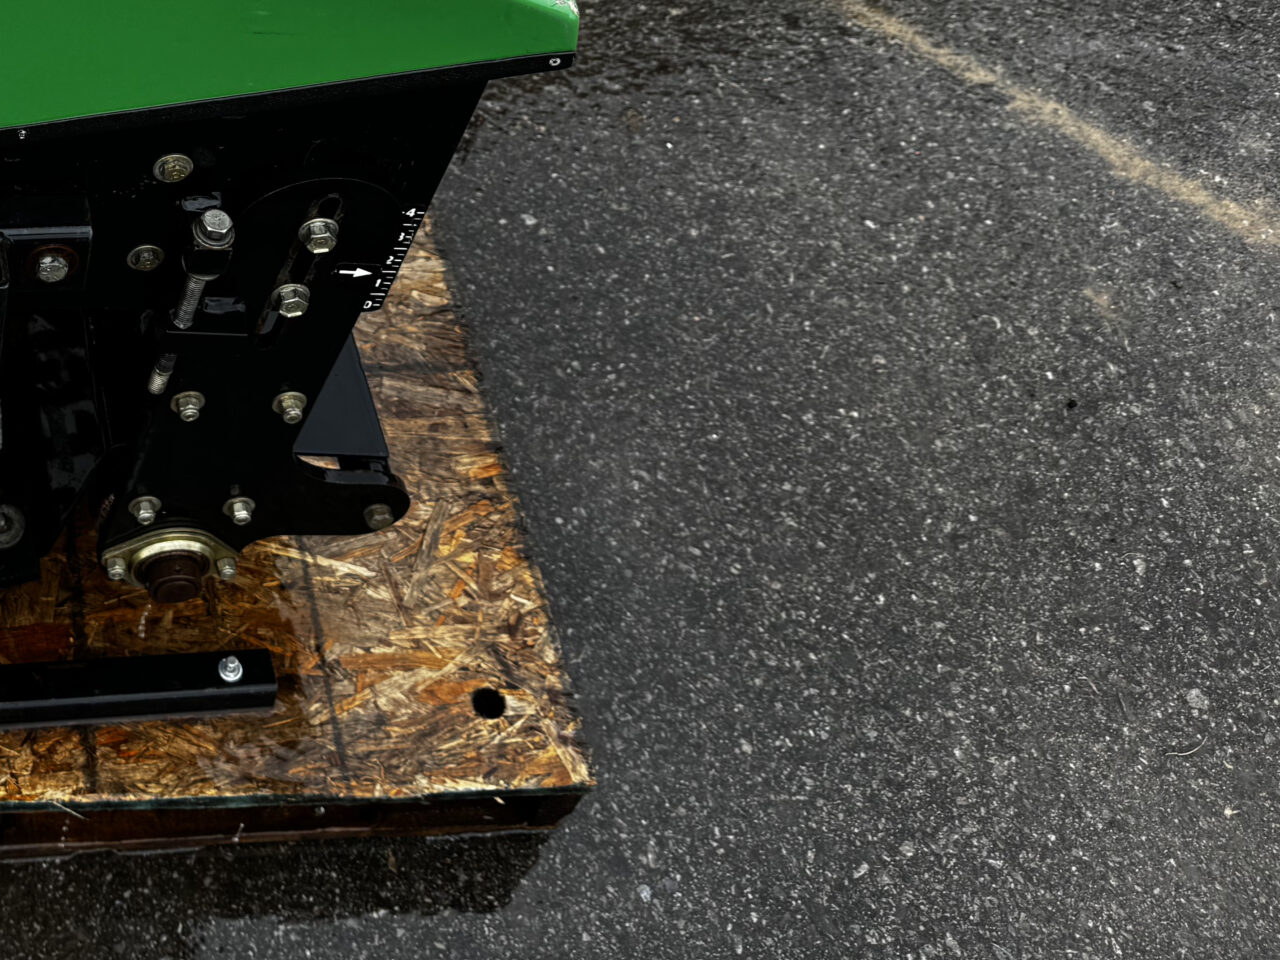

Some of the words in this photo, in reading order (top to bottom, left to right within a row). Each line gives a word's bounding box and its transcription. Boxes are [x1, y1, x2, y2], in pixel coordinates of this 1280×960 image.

[405, 208, 416, 217] 4
[386, 255, 394, 264] 2
[375, 279, 382, 287] 1
[363, 300, 372, 309] 0
